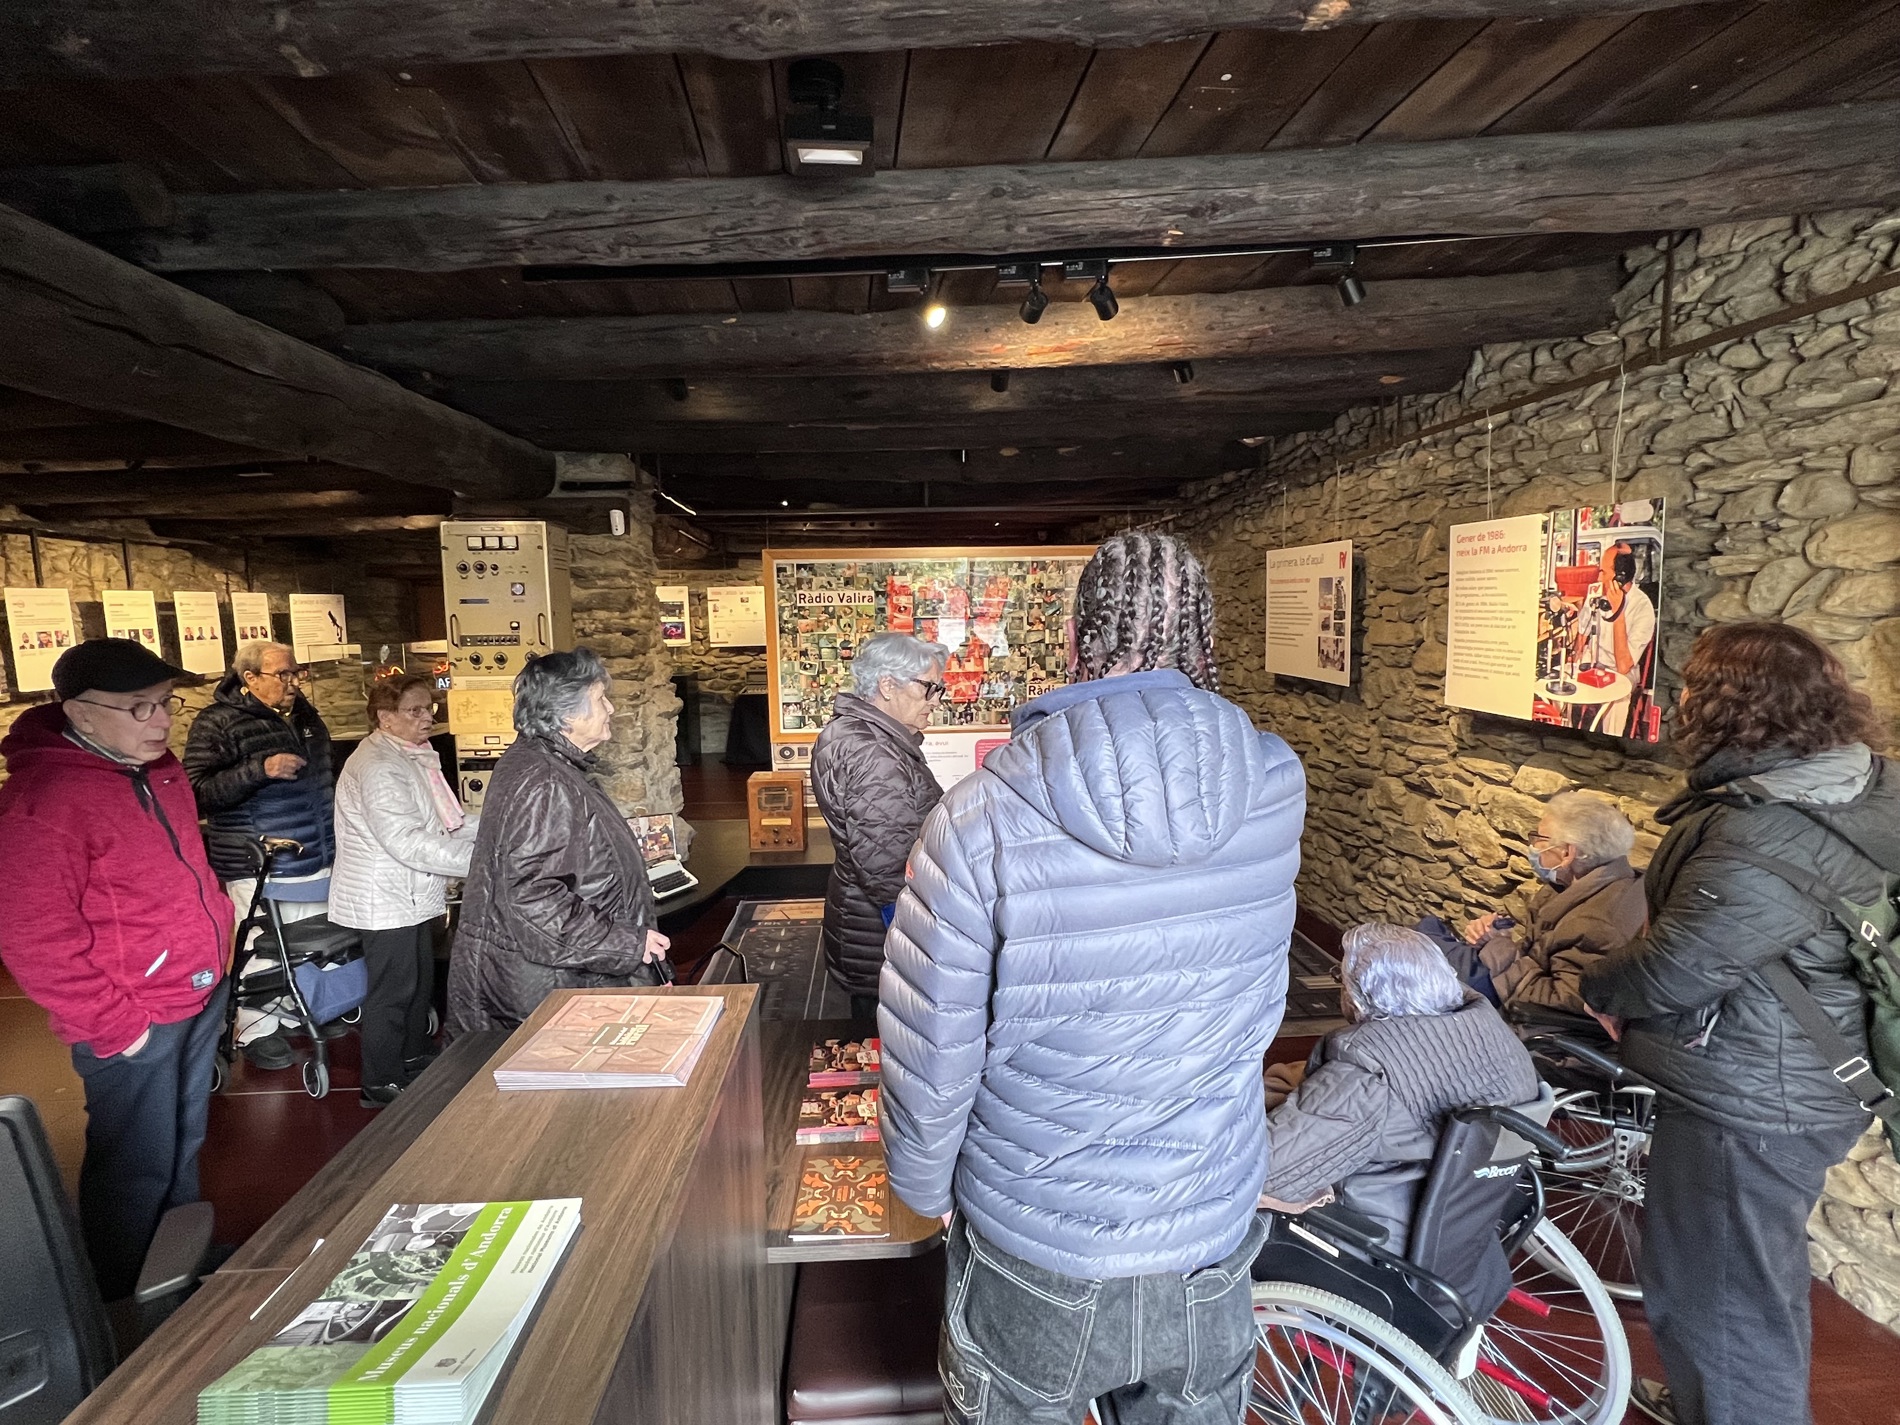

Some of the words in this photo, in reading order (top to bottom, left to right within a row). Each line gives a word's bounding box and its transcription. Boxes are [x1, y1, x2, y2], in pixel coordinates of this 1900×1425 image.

[1456, 534, 1475, 544] Gener
[1477, 532, 1486, 541] de
[1456, 548, 1470, 557] neix
[1471, 547, 1478, 556] la
[1479, 546, 1490, 555] FM
[1497, 544, 1527, 554] Andorra
[798, 592, 834, 604] Ràdio
[837, 592, 874, 604] Valira
[1028, 684, 1055, 696] Ràdi
[356, 1336, 419, 1382] Museus
[413, 1273, 471, 1335] nacionals
